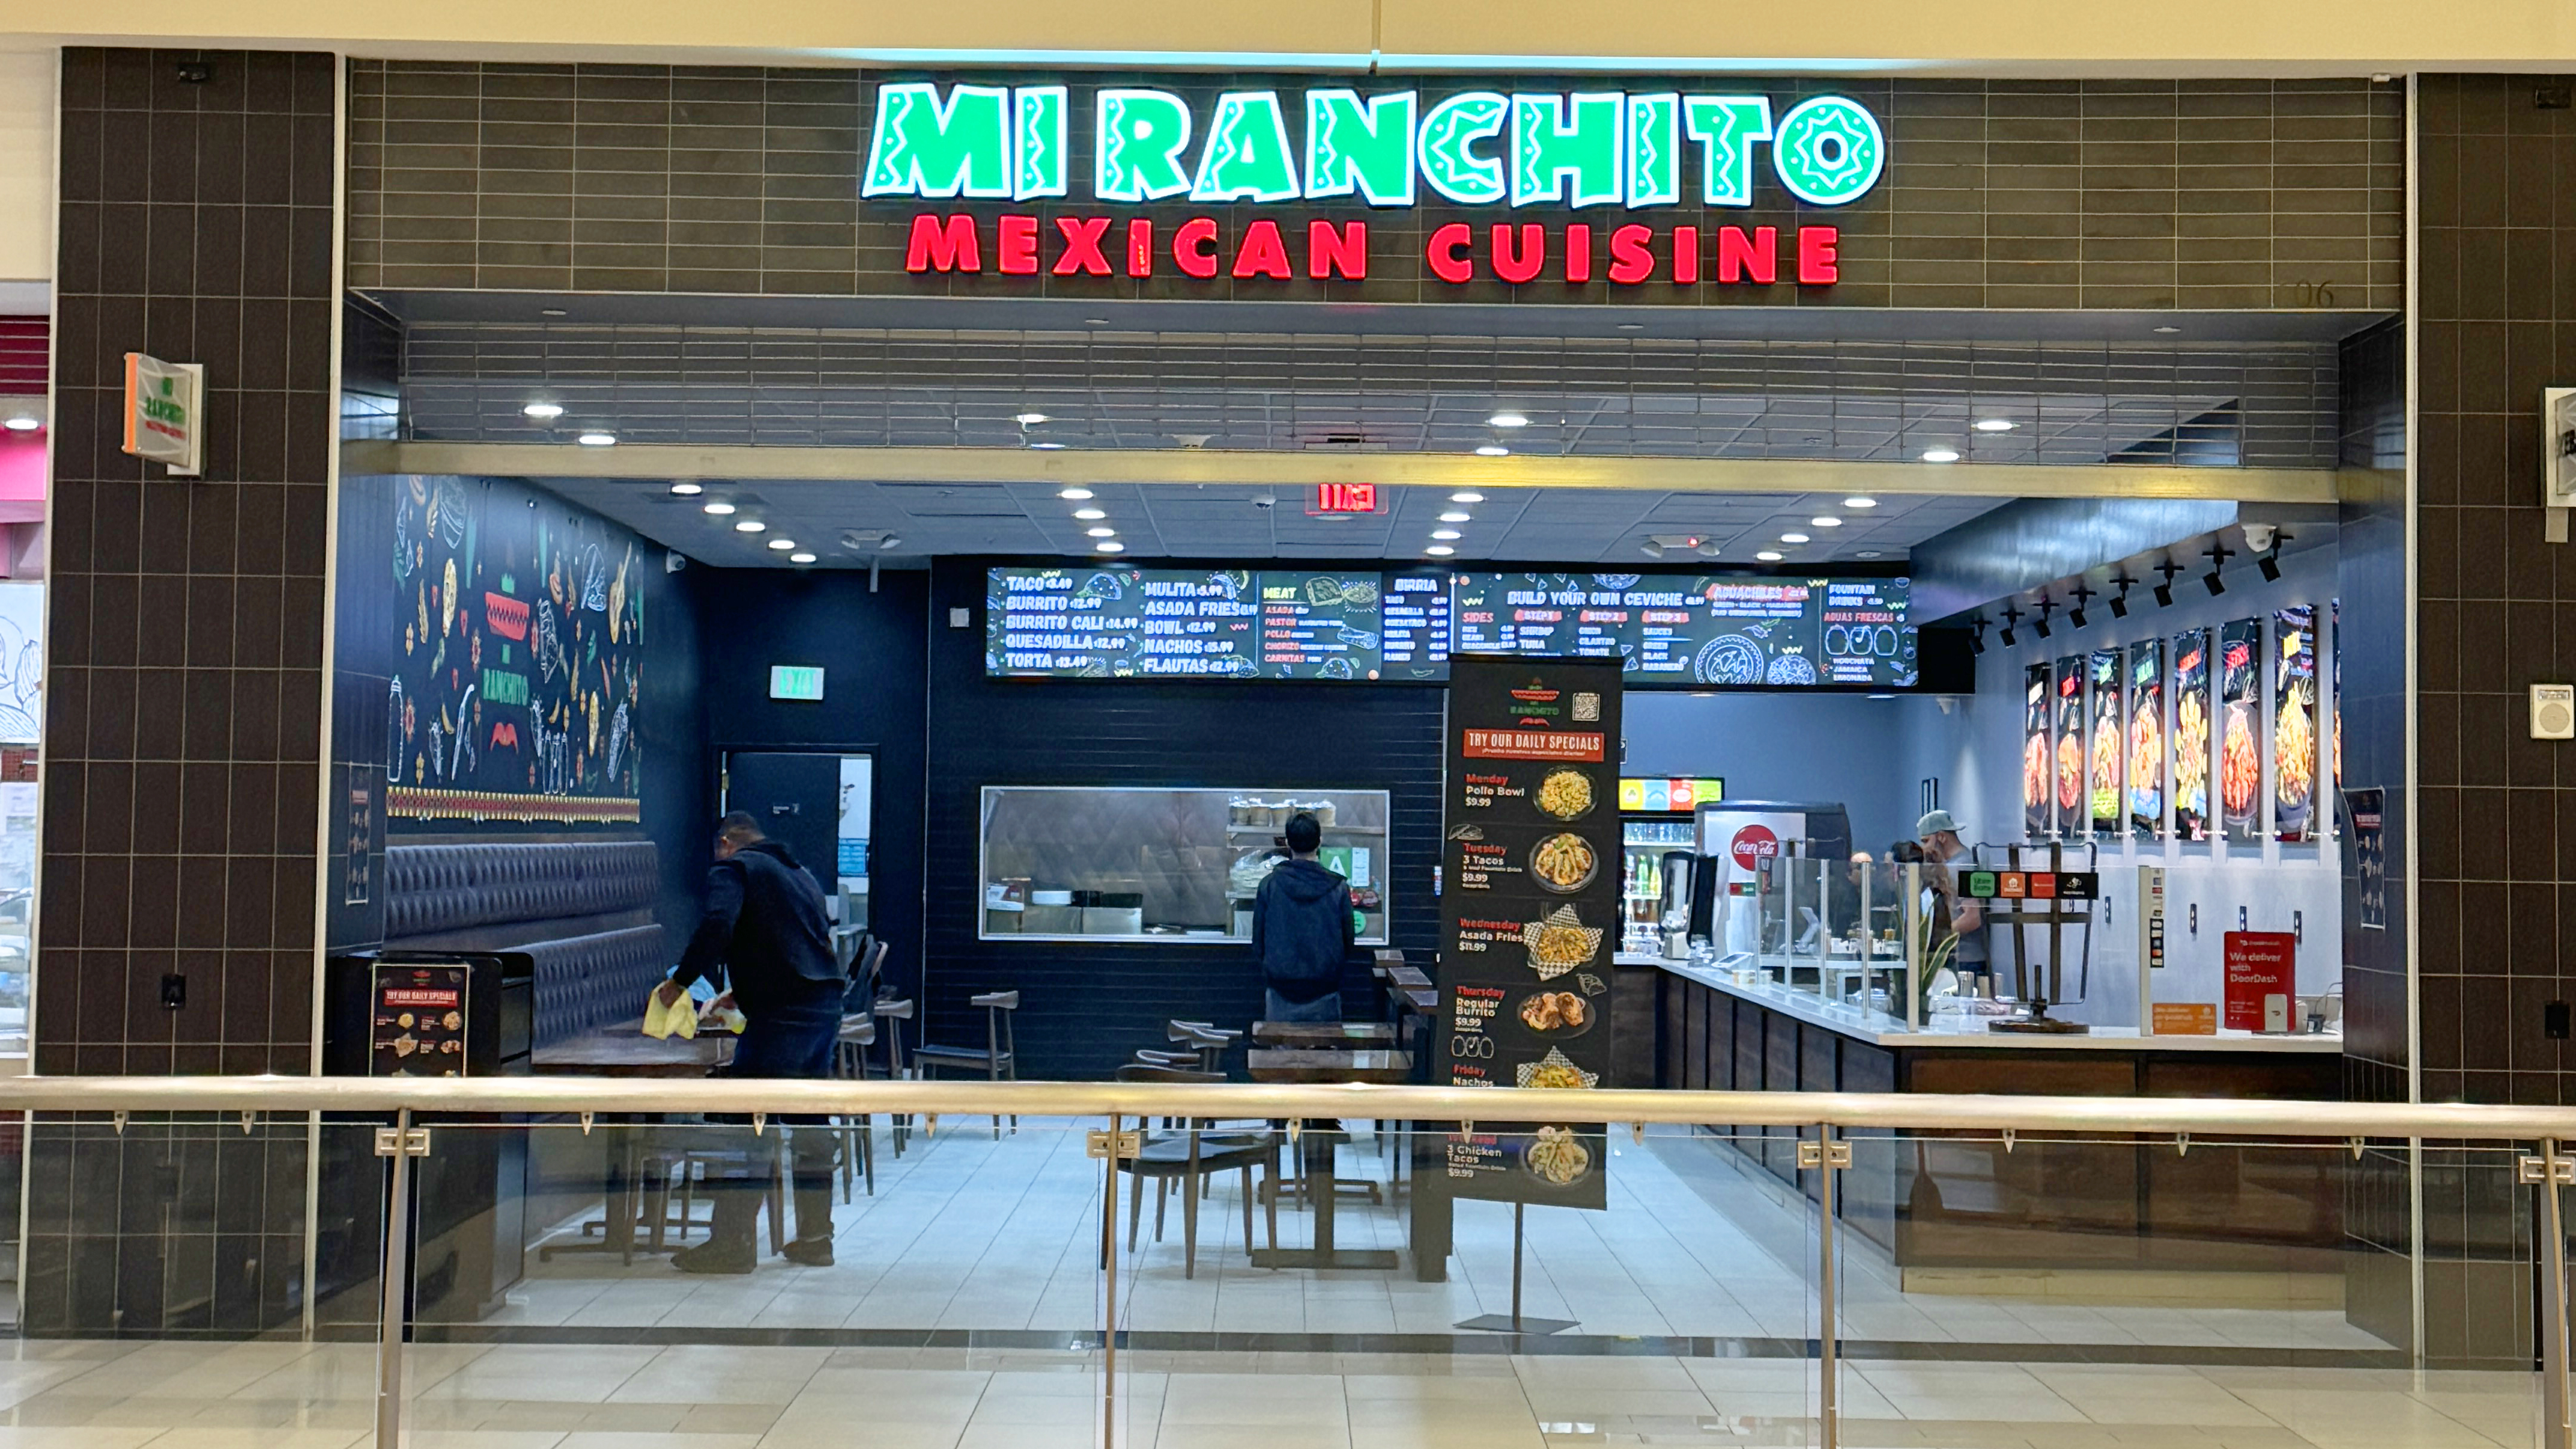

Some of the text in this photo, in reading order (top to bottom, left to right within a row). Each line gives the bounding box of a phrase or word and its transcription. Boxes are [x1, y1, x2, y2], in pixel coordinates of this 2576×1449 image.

[860, 81, 1886, 209] MI RANCHITO
[905, 213, 1840, 286] MEXICAN CUISINE
[1007, 576, 1044, 591] TACO
[1145, 582, 1195, 597] MULITA
[1394, 579, 1437, 592] BIRRIA
[1829, 584, 1875, 594] FOUNTAIN
[1263, 587, 1296, 599] MEAT
[1507, 591, 1547, 605] BUILD
[1550, 591, 1587, 606] YOUR
[1590, 592, 1620, 606] OWN
[1624, 592, 1684, 606] CEVICHE
[1006, 596, 1068, 610] BURRITO
[1829, 596, 1863, 606] DRINKS
[1145, 601, 1195, 616] ASADA
[1199, 601, 1240, 616] FRIES
[1006, 615, 1067, 629] BURRITO
[1072, 616, 1104, 630] CALI
[1462, 612, 1494, 623] SIDES
[1824, 612, 1853, 622] AGUAS
[1855, 612, 1894, 623] FRESCAS
[1145, 621, 1184, 635] BOWL
[1265, 630, 1290, 639] POLLO
[1005, 634, 1093, 650] QUESADILLA
[1144, 639, 1202, 654] NACHOS
[1519, 639, 1545, 649] TUNA
[1005, 653, 1052, 667] TORTA
[1144, 658, 1208, 673] FLAUTAS
[1469, 733, 1599, 751] TRY OUR DAILY SPECIALS
[1465, 774, 1509, 786] Monday
[1465, 786, 1524, 796] Pollo Bowl
[1465, 797, 1491, 807] $9.99
[1464, 843, 1507, 856] Tuesday
[1329, 856, 1347, 877] A
[1463, 855, 1504, 866] 3 Tacos
[1462, 872, 1488, 882] $9.99
[1459, 918, 1521, 932] Wednesday
[1459, 931, 1523, 942] Asada Fries
[1459, 941, 1486, 952] $11.99
[2230, 952, 2281, 962] We deliver
[2230, 973, 2278, 983] DoorDash
[1456, 985, 1505, 1000] Thursday
[1456, 998, 1500, 1009] Regular
[1456, 1007, 1495, 1017] Burrito
[1455, 1017, 1482, 1027] $9.99
[1453, 1063, 1486, 1077] Friday
[1453, 1077, 1494, 1087] Nachos
[1447, 1145, 1502, 1157] 3 Chicken
[1447, 1153, 1479, 1163] Tacos
[1448, 1168, 1474, 1178] $9.99
